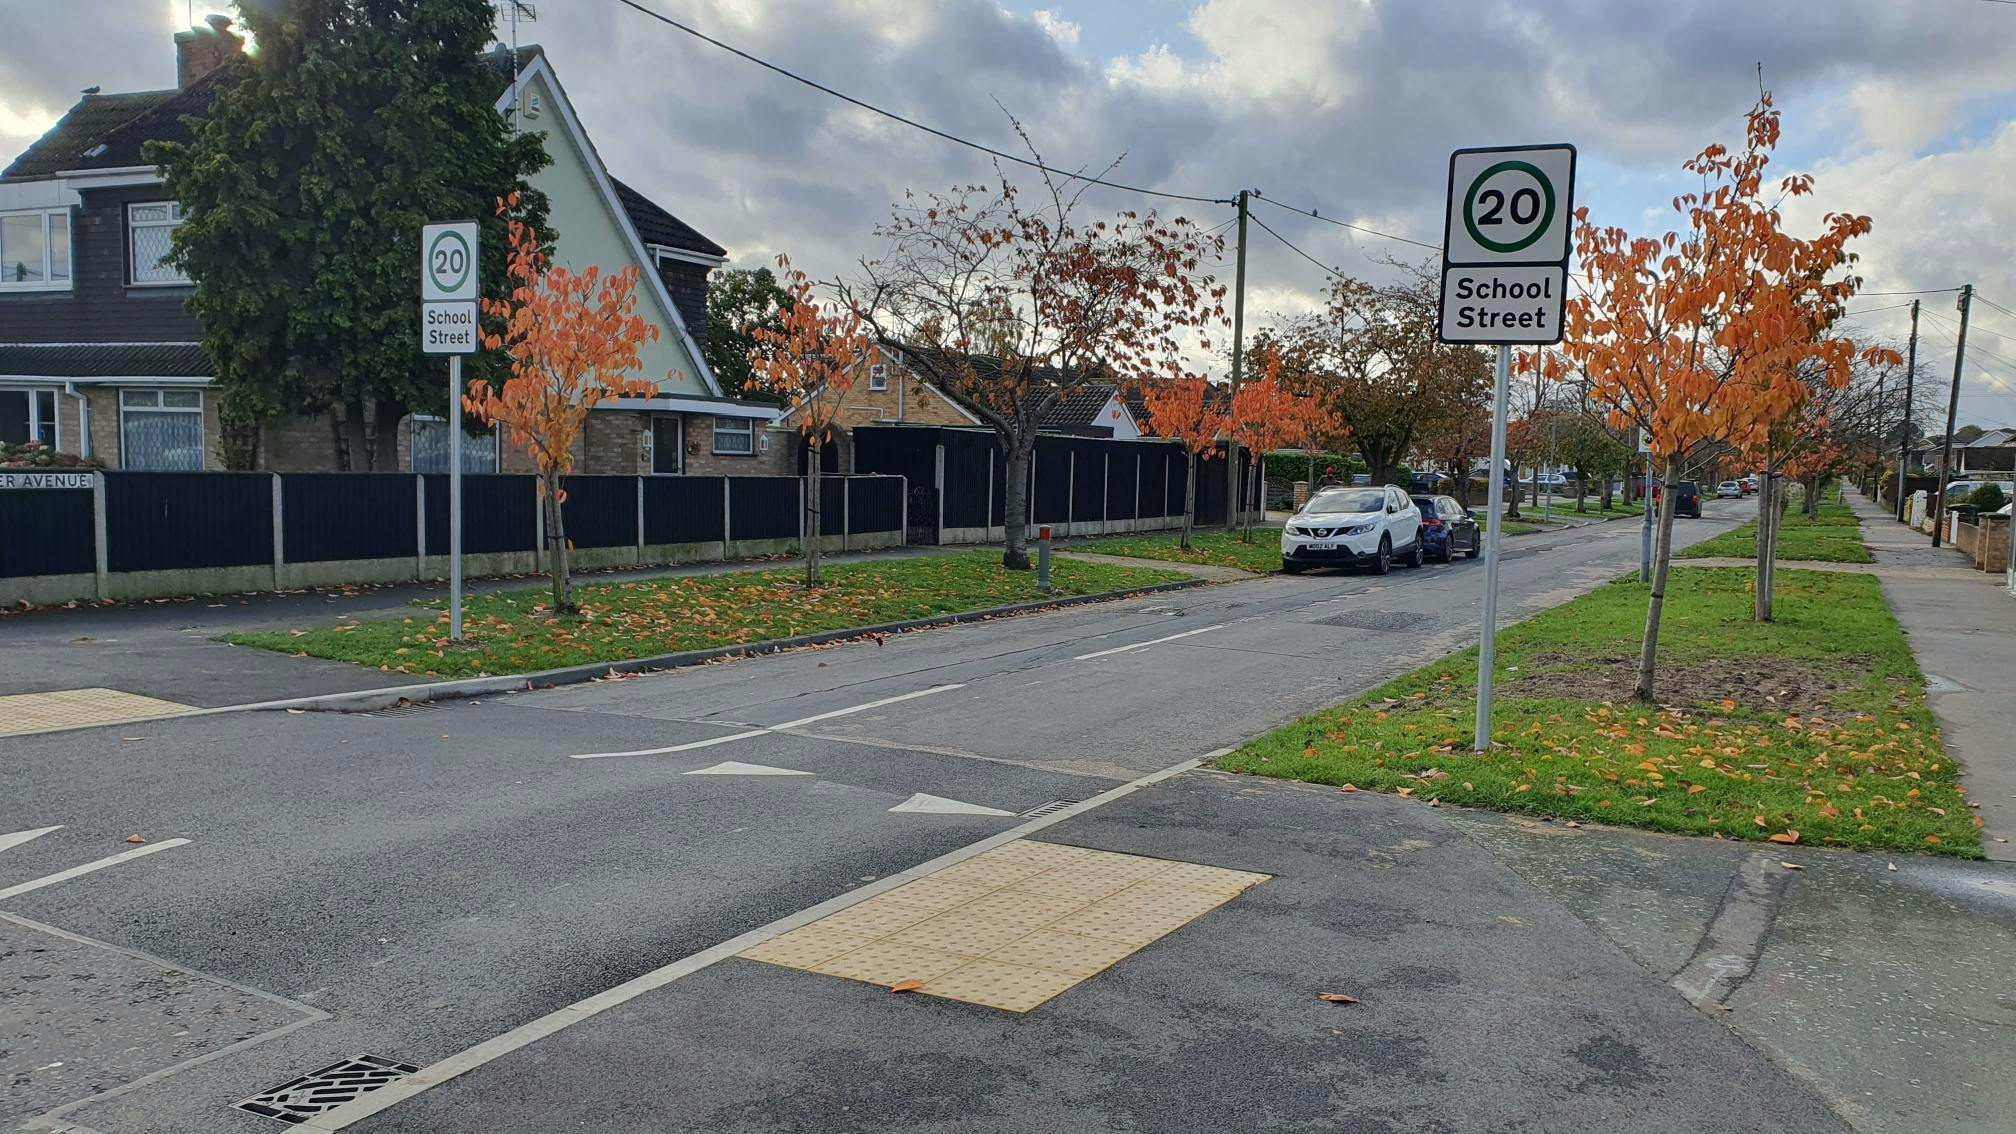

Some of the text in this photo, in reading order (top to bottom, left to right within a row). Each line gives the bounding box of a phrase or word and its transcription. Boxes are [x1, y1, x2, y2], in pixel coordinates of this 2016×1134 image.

[1478, 188, 1540, 225] 20
[435, 248, 464, 274] 20
[1456, 277, 1552, 300] School
[427, 309, 472, 325] School
[1456, 306, 1546, 328] Street
[429, 329, 470, 344] Street
[23, 474, 87, 487] AVENUE
